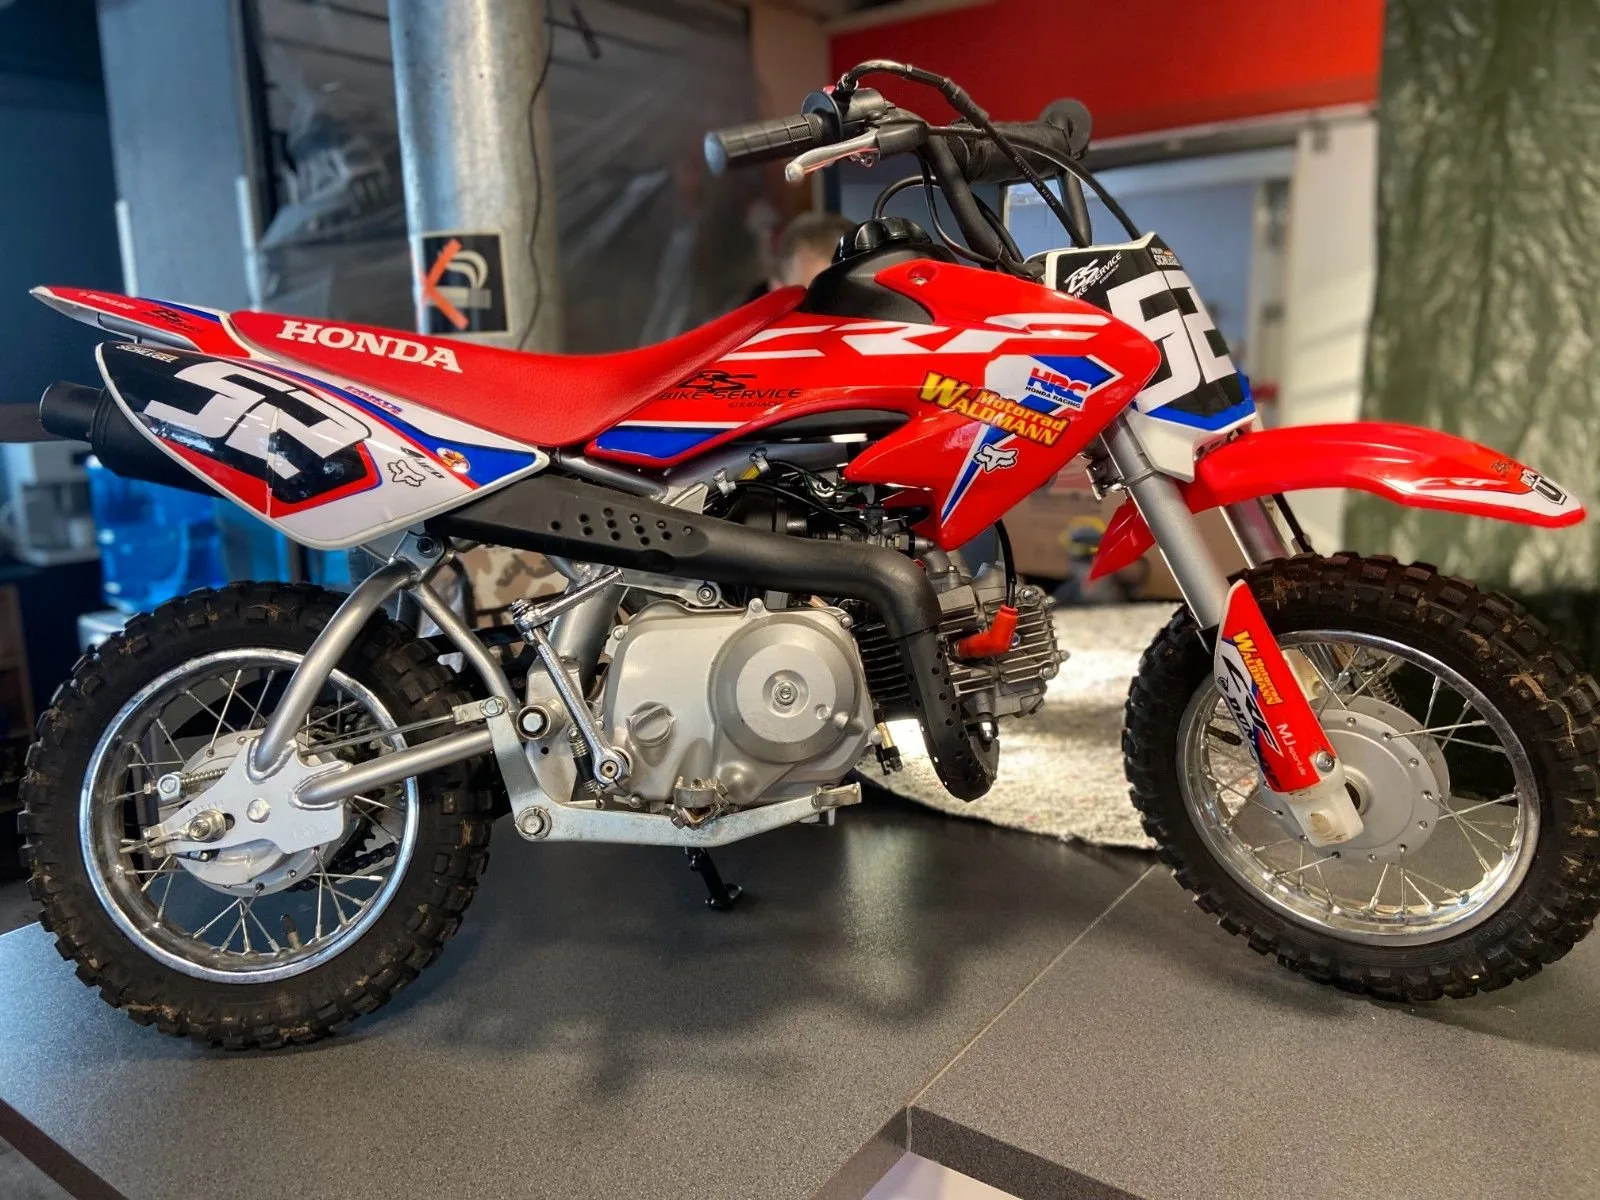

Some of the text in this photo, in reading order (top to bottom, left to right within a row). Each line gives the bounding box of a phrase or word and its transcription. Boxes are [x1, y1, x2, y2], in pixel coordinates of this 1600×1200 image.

[1090, 251, 1122, 286] SERVICE
[277, 320, 463, 374] HONDA
[715, 312, 1111, 363] CRF
[658, 388, 801, 400] BIKE SERVICE
[1025, 386, 1081, 409] HONDA RACING
[1028, 367, 1089, 403] HRC
[920, 372, 1060, 445] WALDMANN
[978, 390, 1069, 430] Motorrad
[1255, 657, 1284, 704] Motorrad
[1221, 655, 1285, 758] CRF
